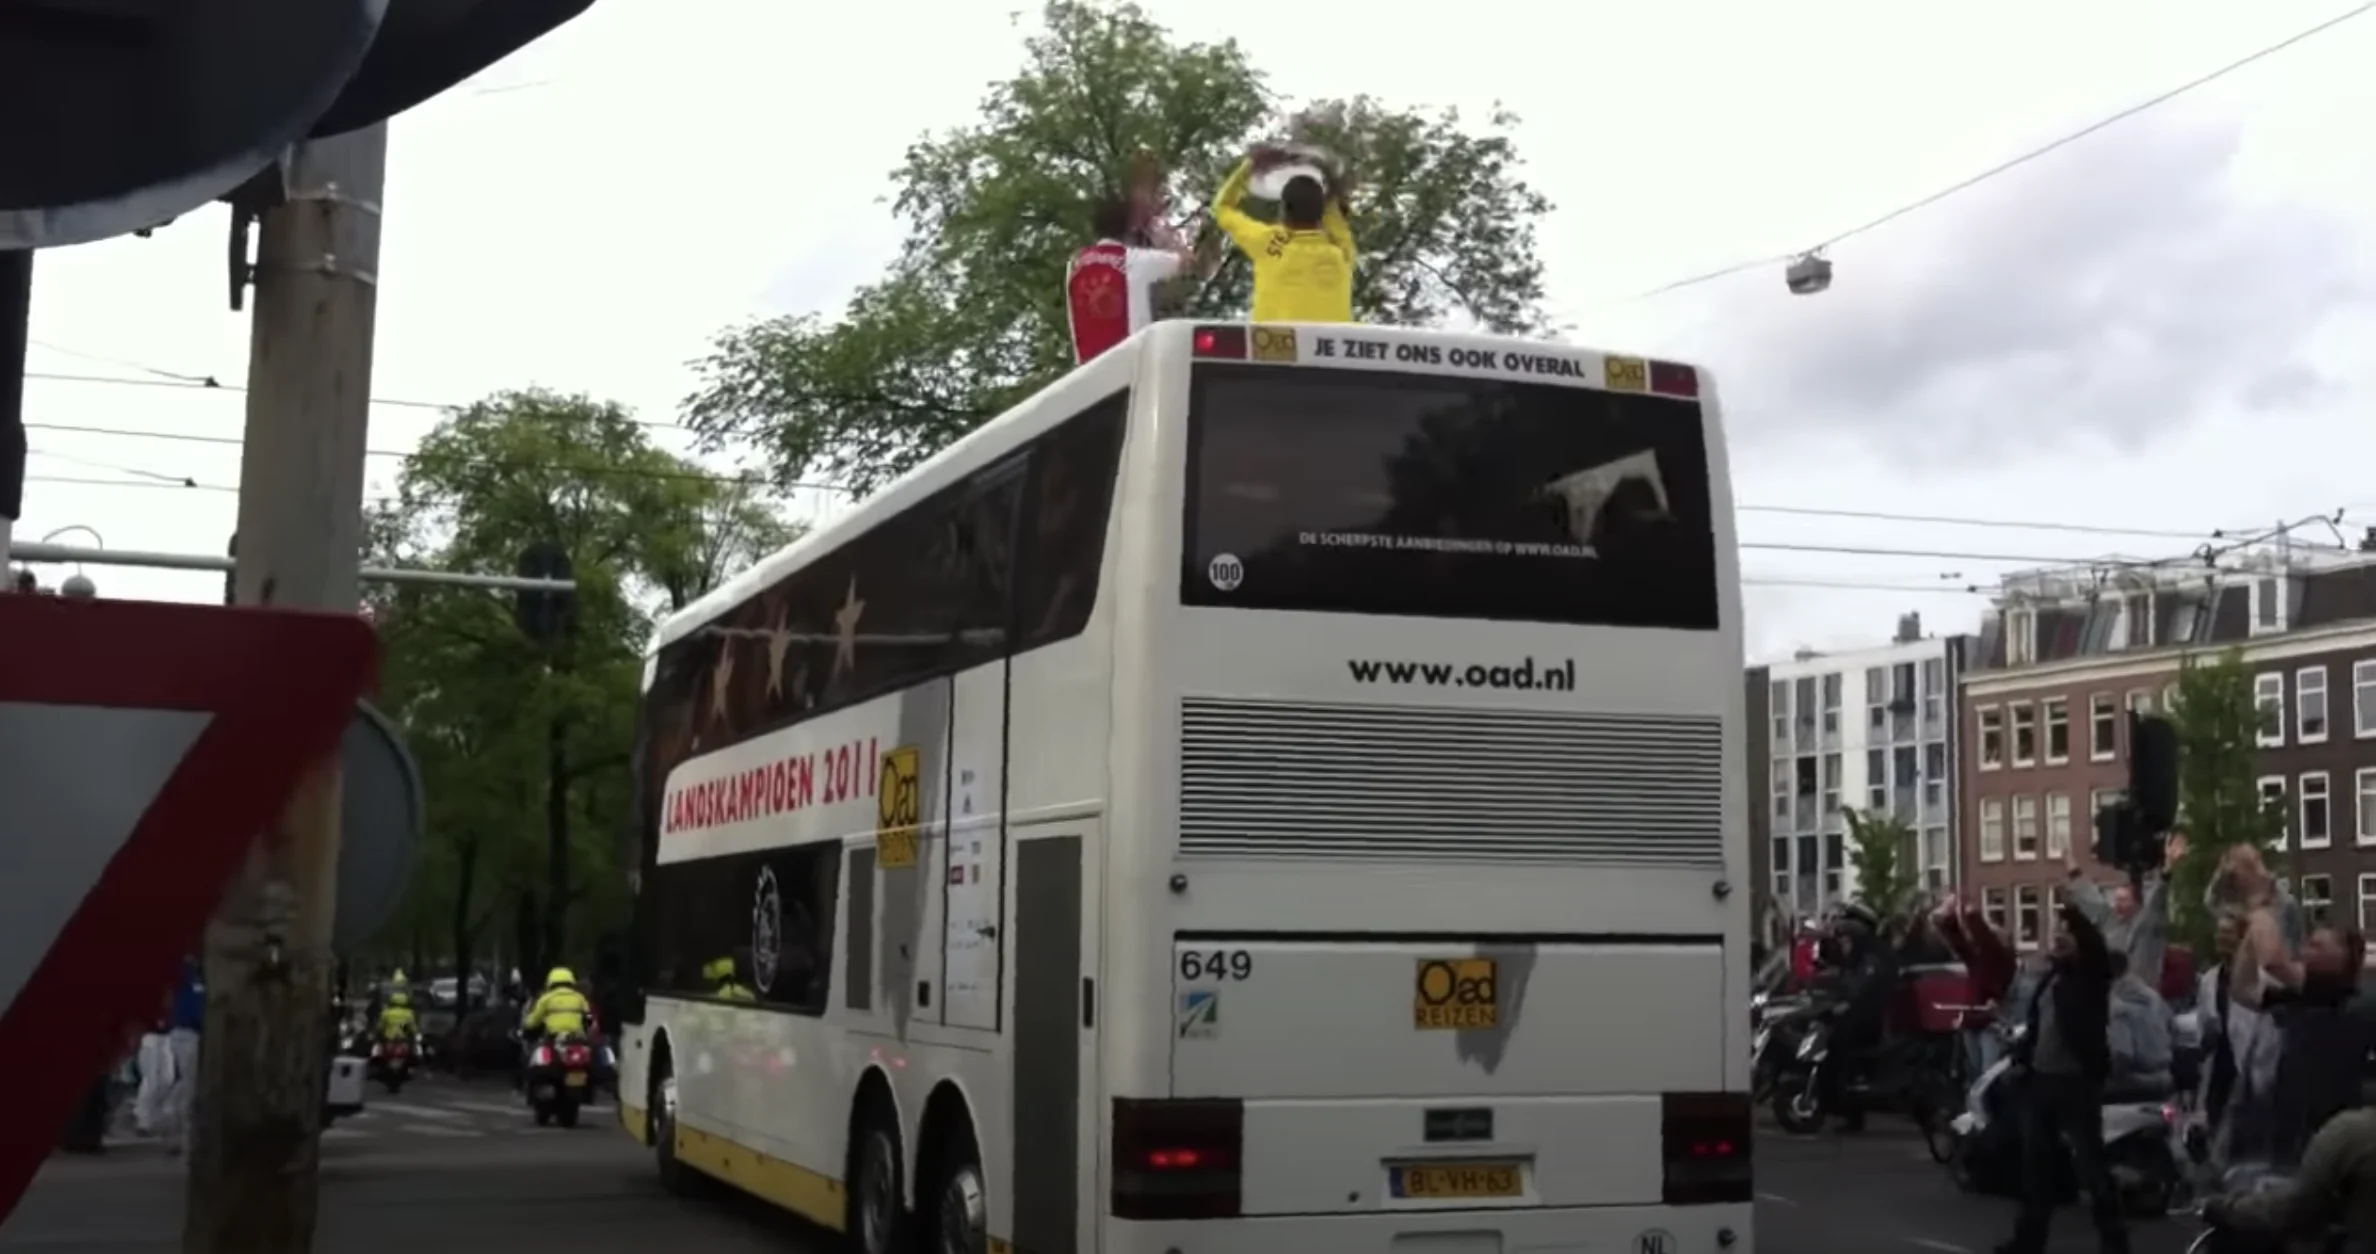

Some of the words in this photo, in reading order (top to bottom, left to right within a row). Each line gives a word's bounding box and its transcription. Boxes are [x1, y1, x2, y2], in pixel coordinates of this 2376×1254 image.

[1314, 337, 1336, 357] JE
[1342, 339, 1389, 360] ZIET
[1396, 343, 1442, 365] ONS
[1448, 347, 1498, 370] OOK
[1503, 352, 1586, 378] OVERAL
[1299, 531, 1317, 545] DE
[1212, 562, 1241, 582] 100
[1347, 655, 1576, 692] www.oad.nl
[666, 754, 815, 835] LANDSKAMPIOEN
[822, 737, 878, 805] 2011
[1181, 949, 1253, 982] 649
[1419, 960, 1497, 1006] Oad
[1415, 1007, 1496, 1027] REIZEN
